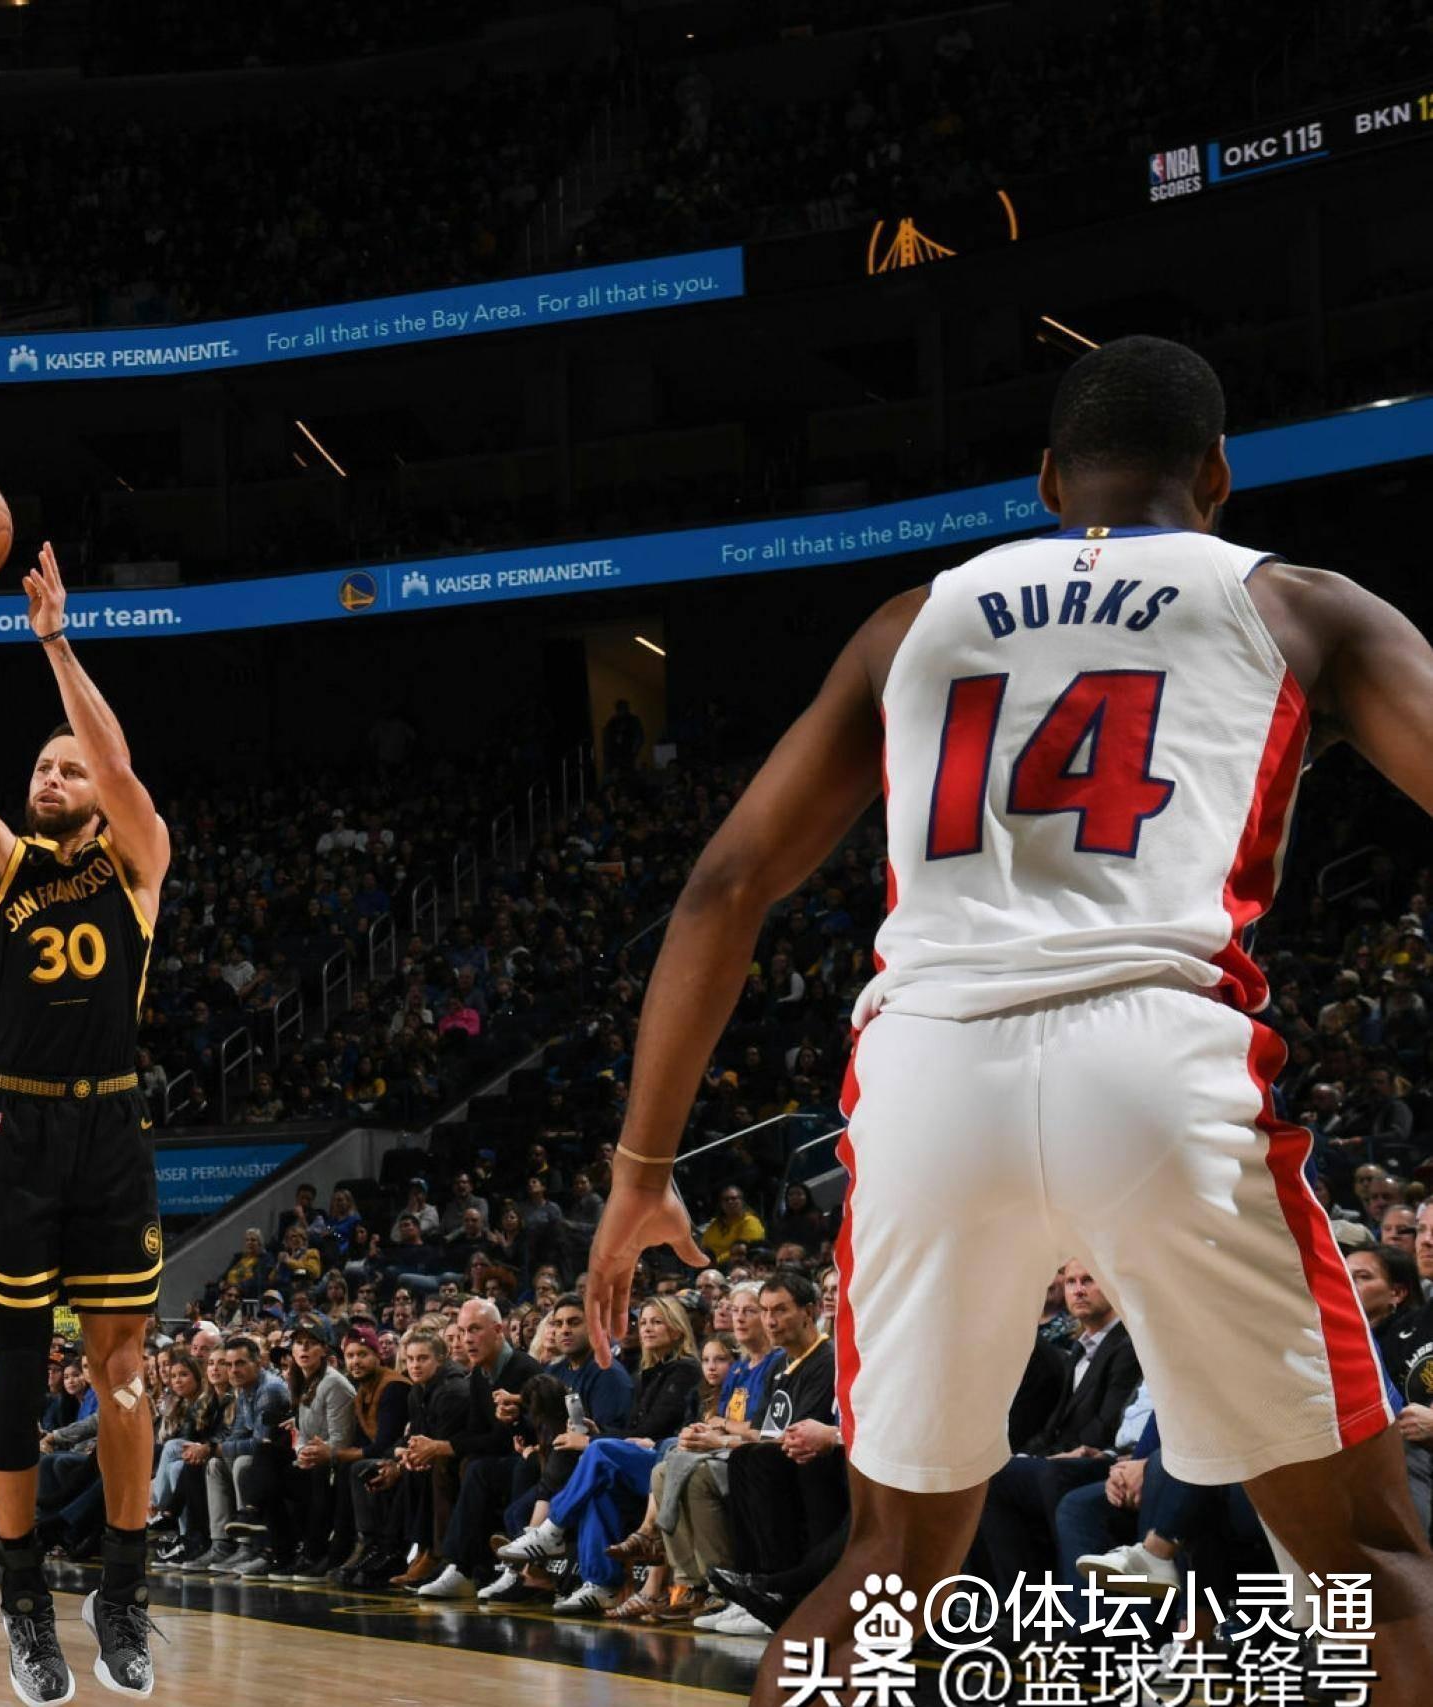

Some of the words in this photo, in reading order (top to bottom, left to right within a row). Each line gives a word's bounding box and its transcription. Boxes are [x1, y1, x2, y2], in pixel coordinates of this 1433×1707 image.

[1356, 102, 1411, 134] BKN
[1166, 145, 1200, 181] NBA
[1225, 138, 1277, 166] OKC
[1283, 123, 1323, 155] 115
[1150, 176, 1202, 202] SCORES
[267, 331, 299, 351] For
[304, 326, 325, 346] all
[331, 321, 369, 342] that
[374, 318, 389, 338] is
[395, 313, 426, 334] the
[433, 308, 468, 335] Bay
[474, 300, 527, 322] Area.
[538, 294, 569, 314] For
[576, 288, 601, 309] all
[606, 282, 646, 304] that
[652, 278, 668, 298] is
[674, 275, 719, 302] you.
[46, 348, 105, 370] KAISER
[721, 543, 754, 562] For
[762, 537, 786, 559] all
[792, 531, 833, 554] that
[838, 526, 855, 547] is
[862, 521, 892, 544] the
[898, 517, 935, 545] Bay
[940, 507, 994, 531] Area.
[1004, 500, 1039, 520] For
[435, 573, 491, 595] KAISER
[62, 611, 99, 628] our
[105, 606, 182, 627] team.
[978, 579, 1181, 639] BURKS
[926, 669, 1176, 861] 14
[5, 891, 39, 933] SAN
[36, 857, 114, 909] FRANCISCO
[28, 922, 107, 983] 30
[773, 1402, 786, 1417] 31
